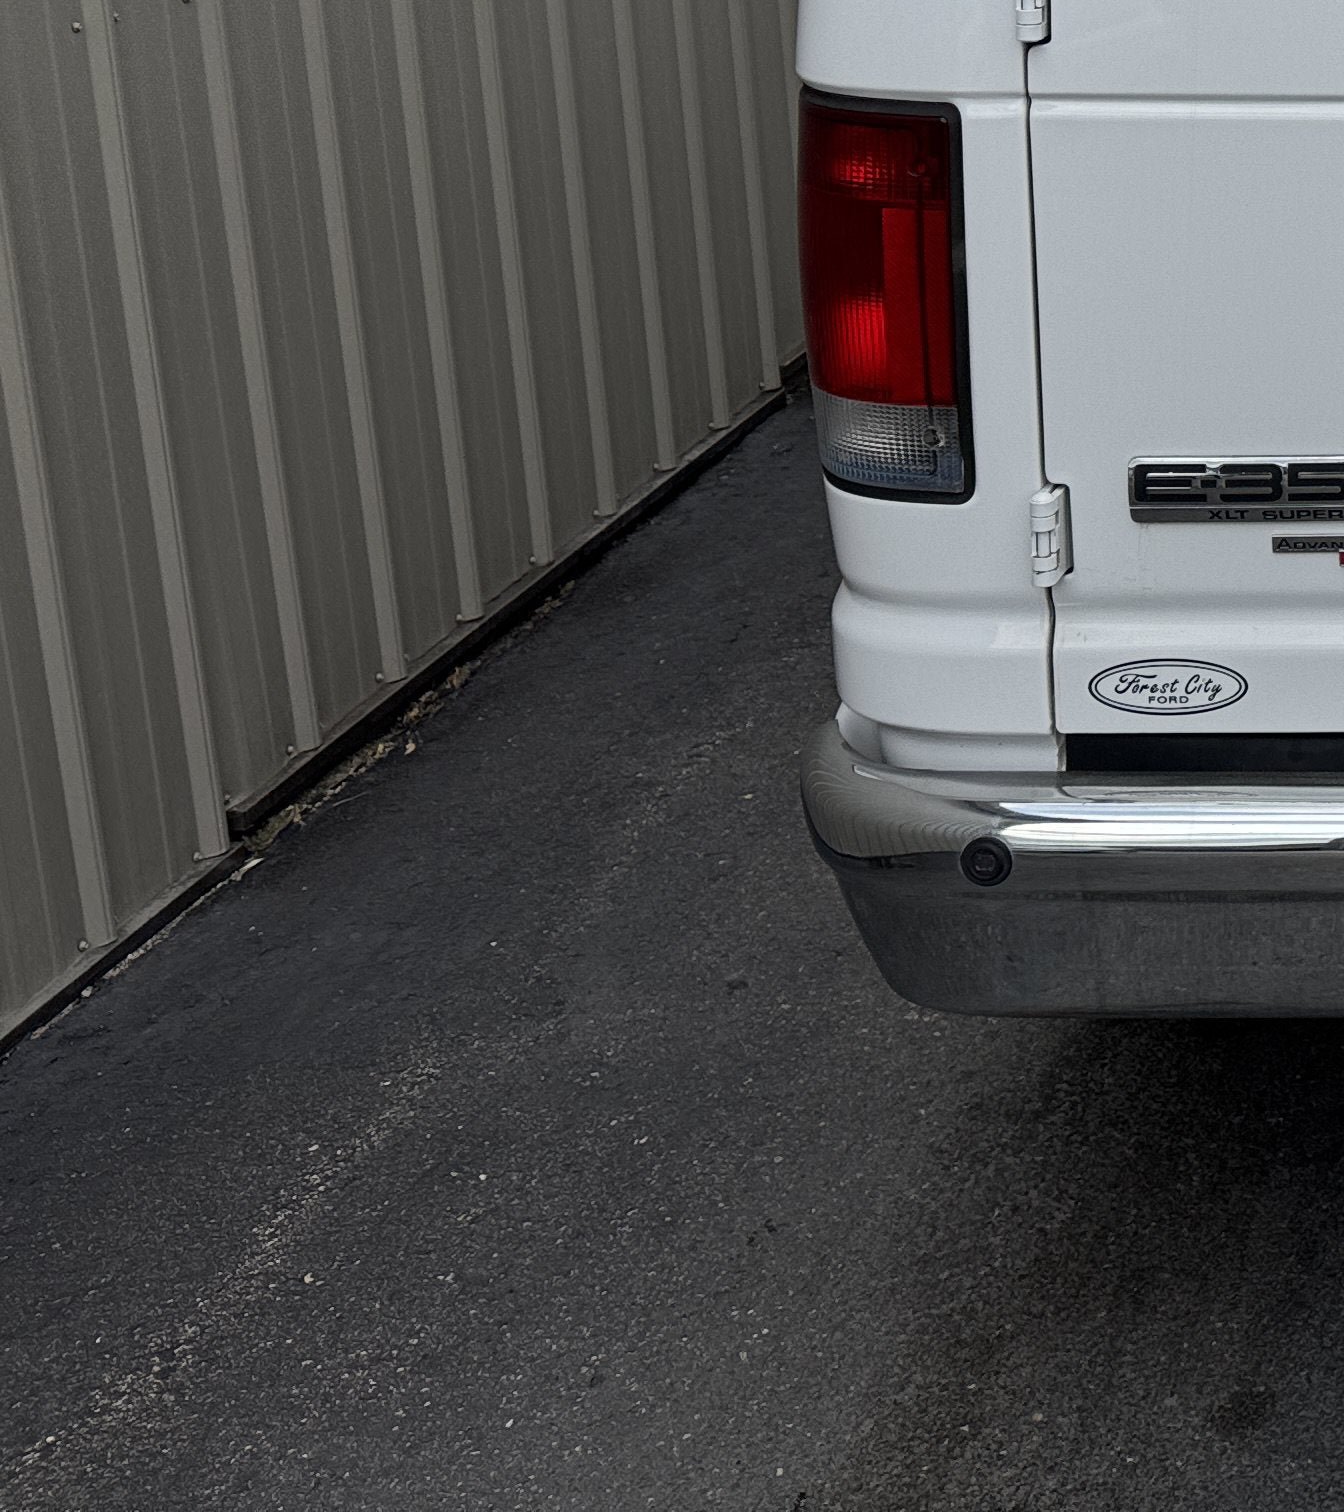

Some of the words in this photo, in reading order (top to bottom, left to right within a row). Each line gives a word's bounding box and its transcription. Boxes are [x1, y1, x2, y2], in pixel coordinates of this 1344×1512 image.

[1208, 509, 1250, 521] XLT
[1262, 508, 1344, 521] SUPER
[1114, 673, 1180, 694] Forest
[1184, 674, 1223, 701] City
[1148, 695, 1189, 704] FORD
